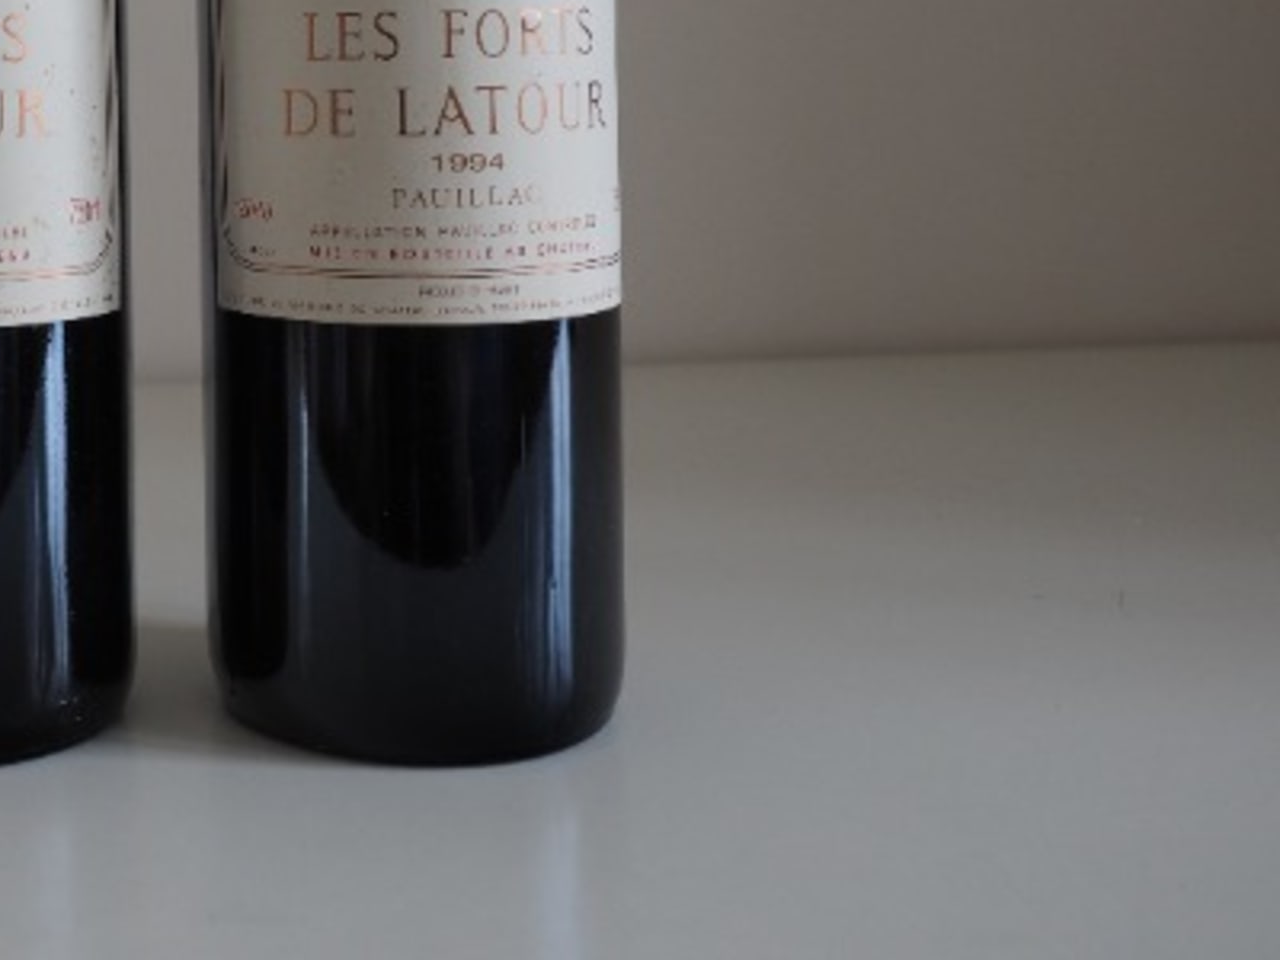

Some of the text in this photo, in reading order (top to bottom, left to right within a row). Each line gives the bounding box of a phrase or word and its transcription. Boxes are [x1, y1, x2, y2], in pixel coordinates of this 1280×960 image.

[303, 6, 594, 62] LES FORTS
[282, 78, 608, 138] DE LATOUR
[430, 152, 505, 173] 1994
[392, 184, 543, 210] PAUILLAC
